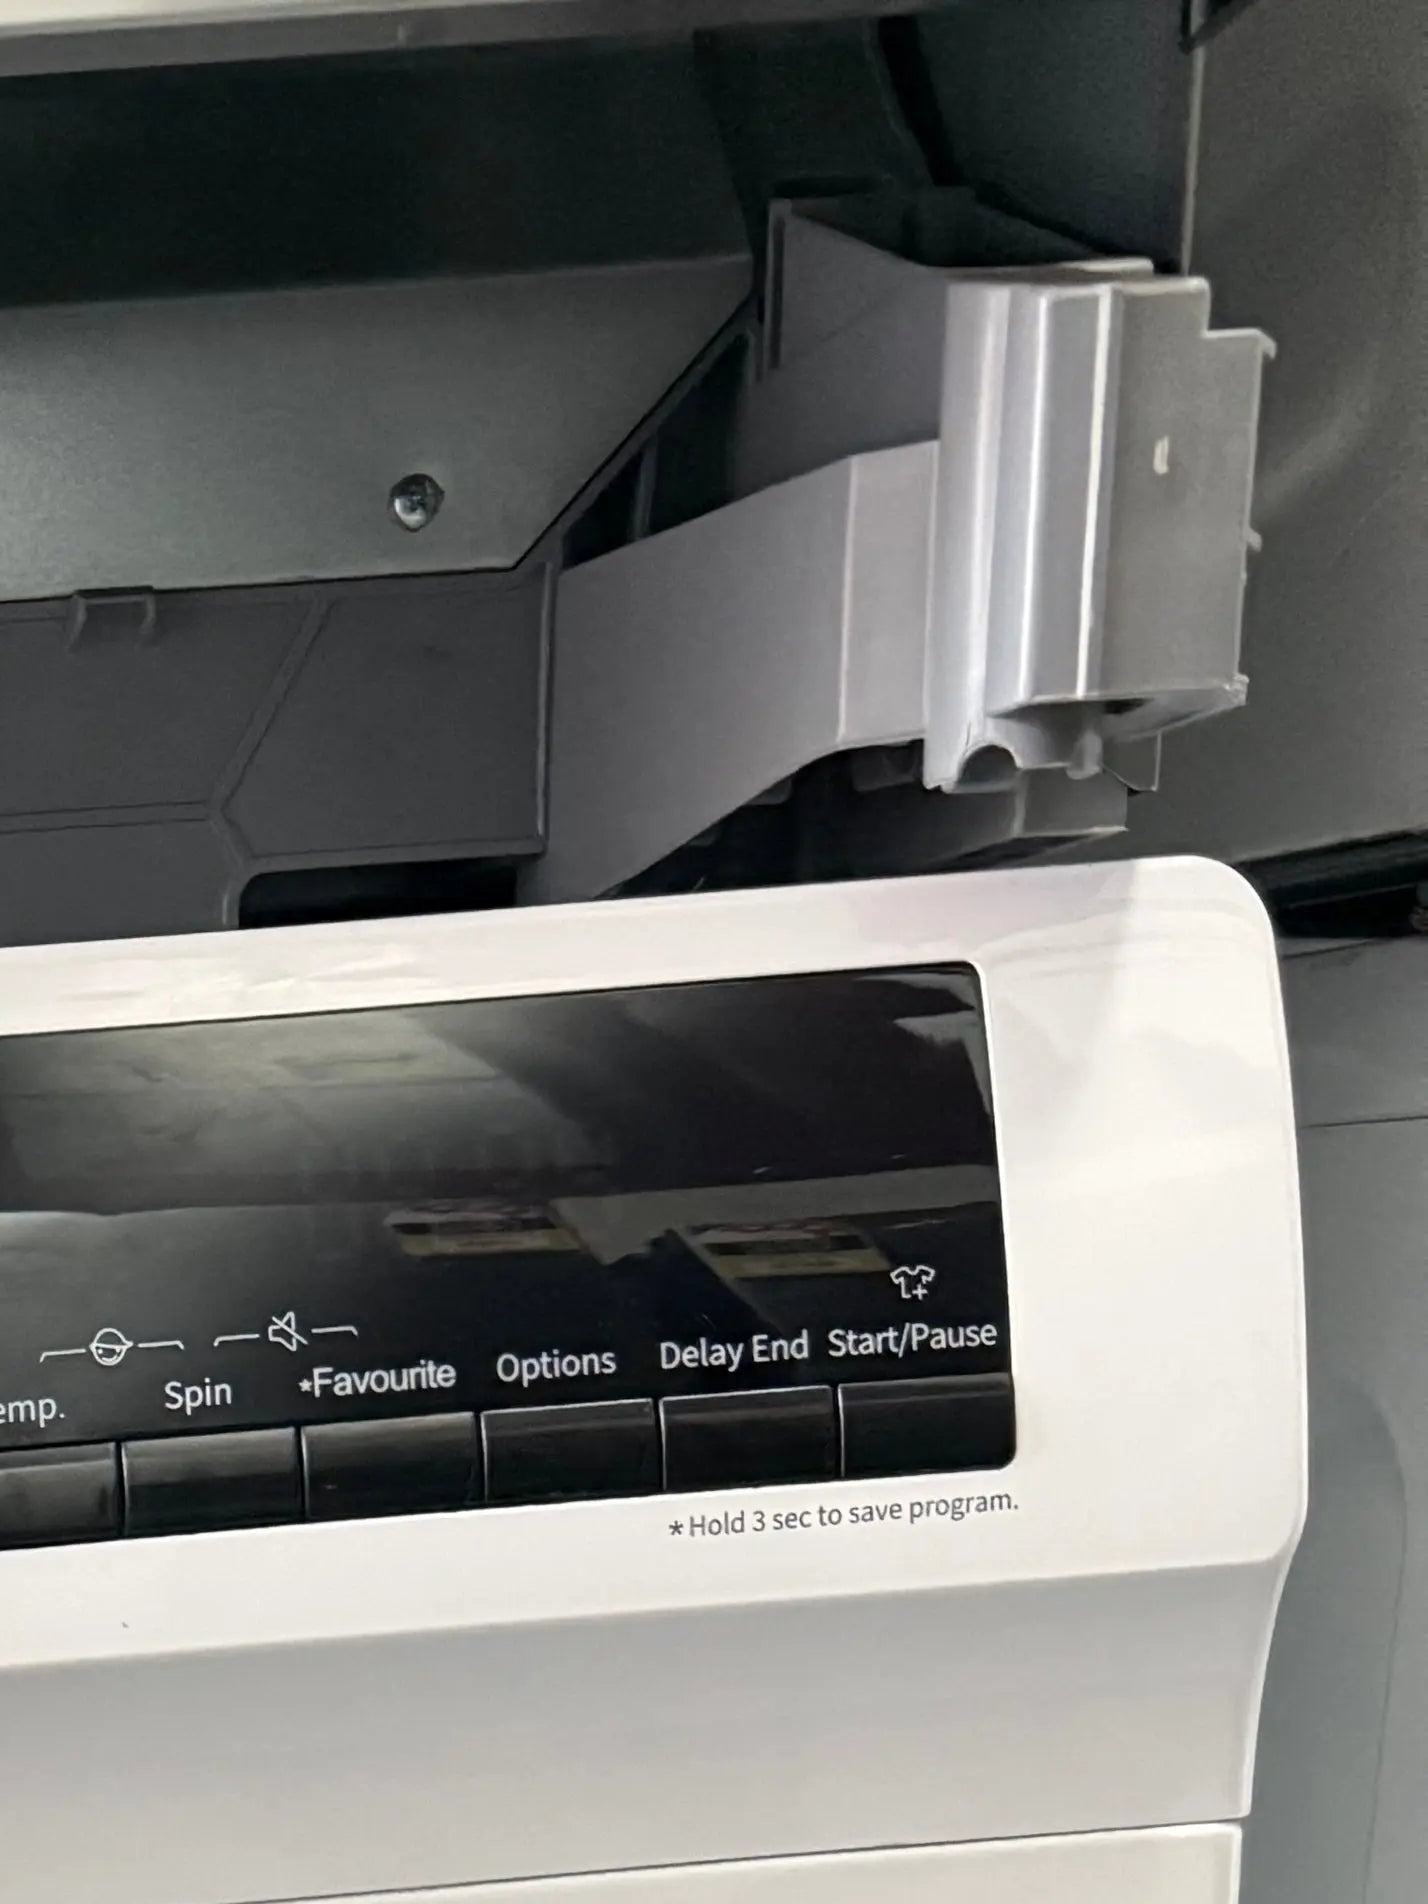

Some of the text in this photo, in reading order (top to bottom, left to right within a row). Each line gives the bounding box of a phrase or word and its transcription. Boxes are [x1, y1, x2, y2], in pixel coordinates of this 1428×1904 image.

[660, 1330, 809, 1374] Delay End
[828, 1319, 998, 1359] Start/Pause
[496, 1346, 617, 1384] Options
[164, 1376, 233, 1412] Spin
[753, 1511, 765, 1531] 3
[773, 1510, 811, 1529] sec
[819, 1506, 842, 1527] to
[849, 1503, 902, 1523] save
[910, 1494, 1019, 1524] program.
